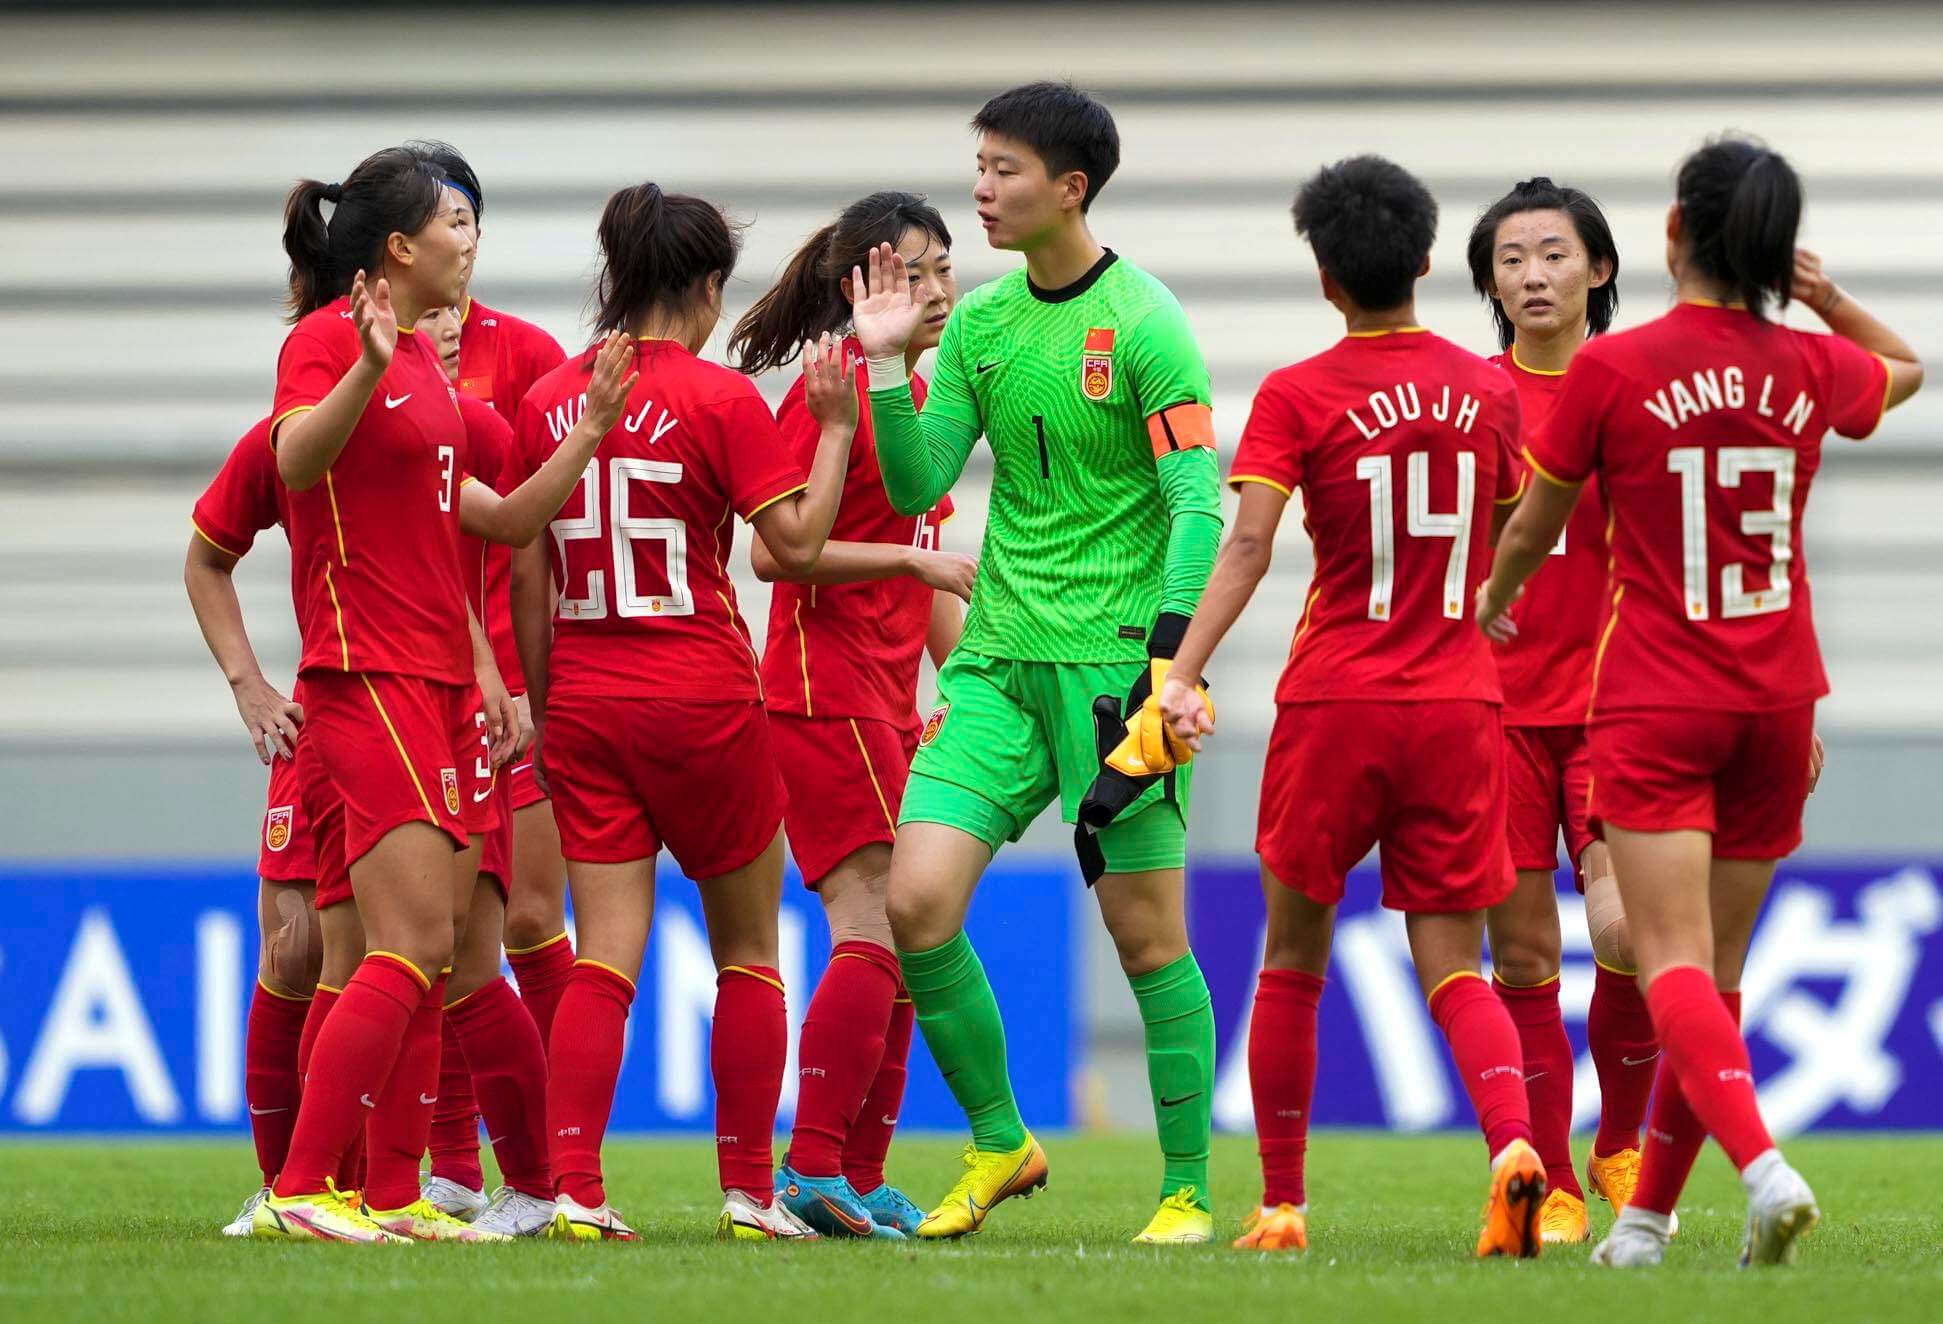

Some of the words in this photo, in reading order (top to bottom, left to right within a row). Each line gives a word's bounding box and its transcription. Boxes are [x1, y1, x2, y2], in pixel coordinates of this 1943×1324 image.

[1346, 382, 1422, 440] LOU
[1643, 366, 1746, 430] YANG
[438, 445, 454, 512] 3
[1032, 416, 1049, 479] 1
[544, 457, 695, 619] 26
[1356, 451, 1476, 621] 14
[1667, 446, 1796, 621] 13
[475, 711, 491, 778] 3
